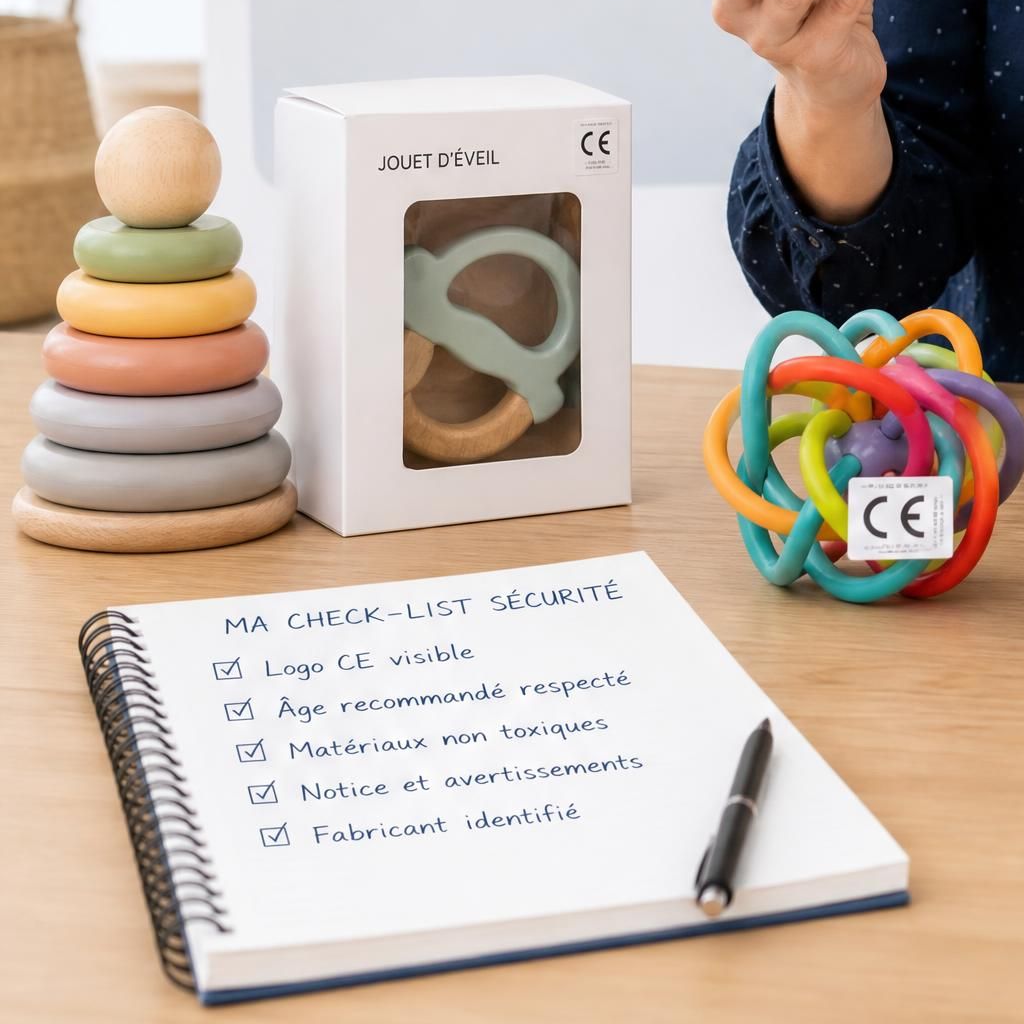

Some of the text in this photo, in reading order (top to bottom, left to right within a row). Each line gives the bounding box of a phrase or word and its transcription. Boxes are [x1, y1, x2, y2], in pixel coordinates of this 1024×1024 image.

[378, 148, 499, 171] JOUET D'ÉVEIL
[581, 130, 610, 156] CE
[863, 495, 924, 538] CE
[225, 578, 624, 635] MA CHECK-LIST SÉCURITÉ
[265, 643, 475, 681] Logo CE visible
[278, 669, 632, 724] Âge recommandé respecté
[289, 718, 609, 760] Matériaux non toxiques
[301, 754, 644, 802] Notice et avertissements
[312, 802, 581, 845] Fabricant identifié
